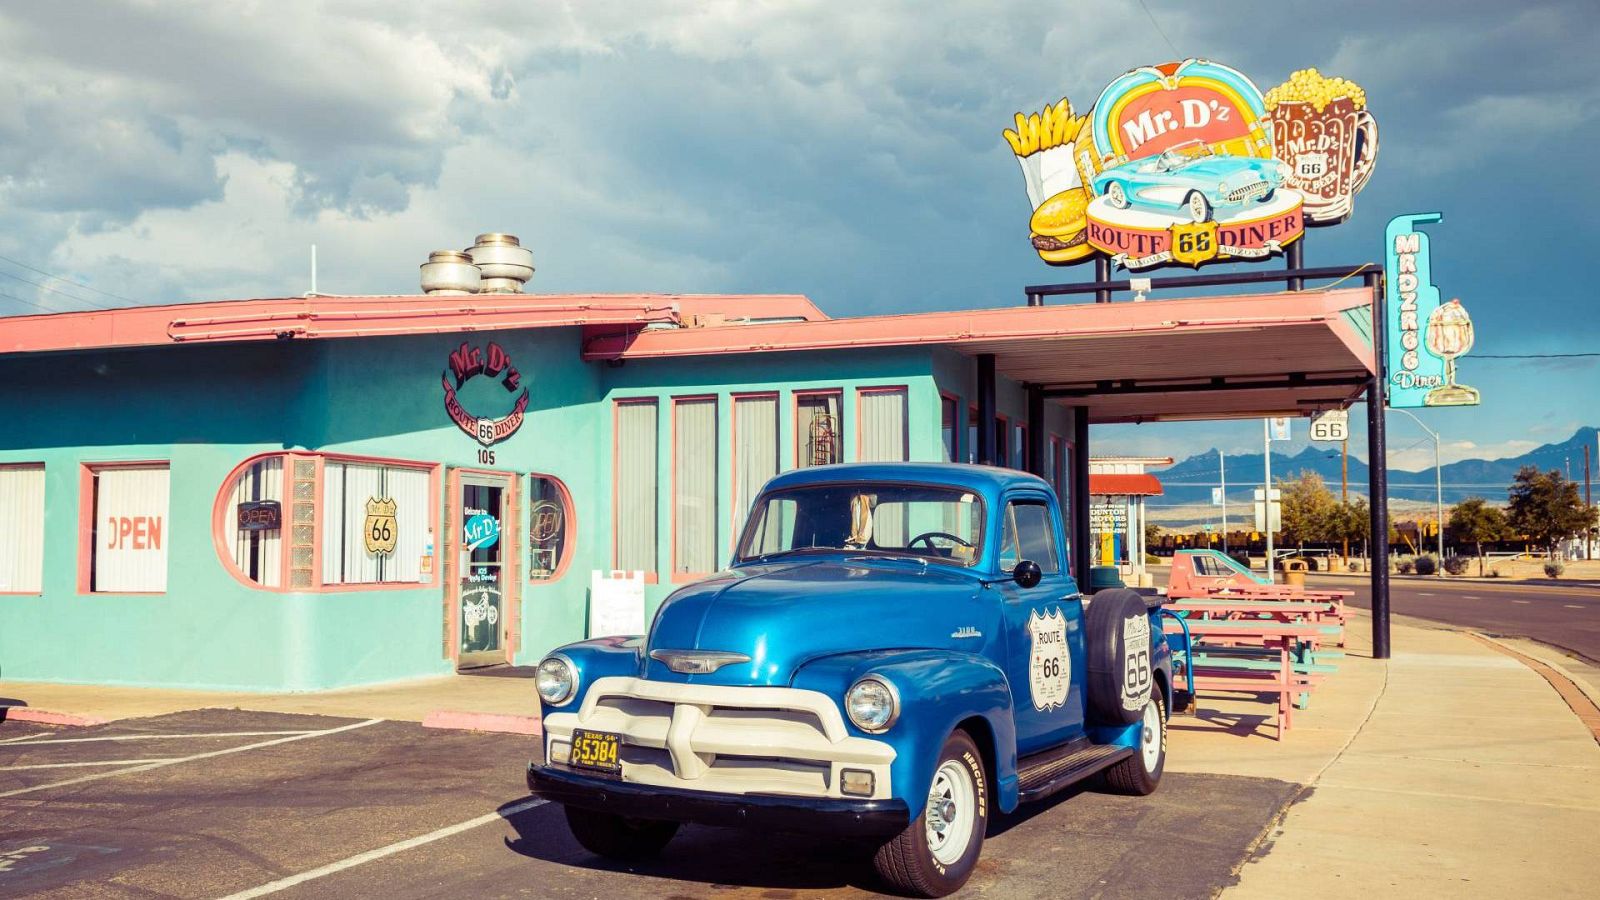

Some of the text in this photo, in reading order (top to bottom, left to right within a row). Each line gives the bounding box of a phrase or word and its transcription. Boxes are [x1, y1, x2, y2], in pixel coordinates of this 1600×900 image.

[1122, 99, 1230, 152] Mr. D'z
[1301, 163, 1321, 174] 66
[1090, 215, 1296, 255] ROUTE 66 DINER
[1222, 246, 1266, 256] ARIZONA
[449, 341, 484, 389] Mr.
[1392, 370, 1443, 389] Diner
[447, 398, 521, 439] ROUTE 66 DINER
[1315, 423, 1342, 437] 66
[477, 449, 496, 465] 105
[239, 508, 277, 524] OPEN
[372, 518, 391, 542] 66
[1038, 630, 1061, 645] ROUTE
[1043, 657, 1060, 679] 66
[1127, 651, 1148, 689] 66
[584, 732, 603, 740] TEXAS
[581, 739, 618, 765] 5384
[962, 751, 986, 818] HERCULES
